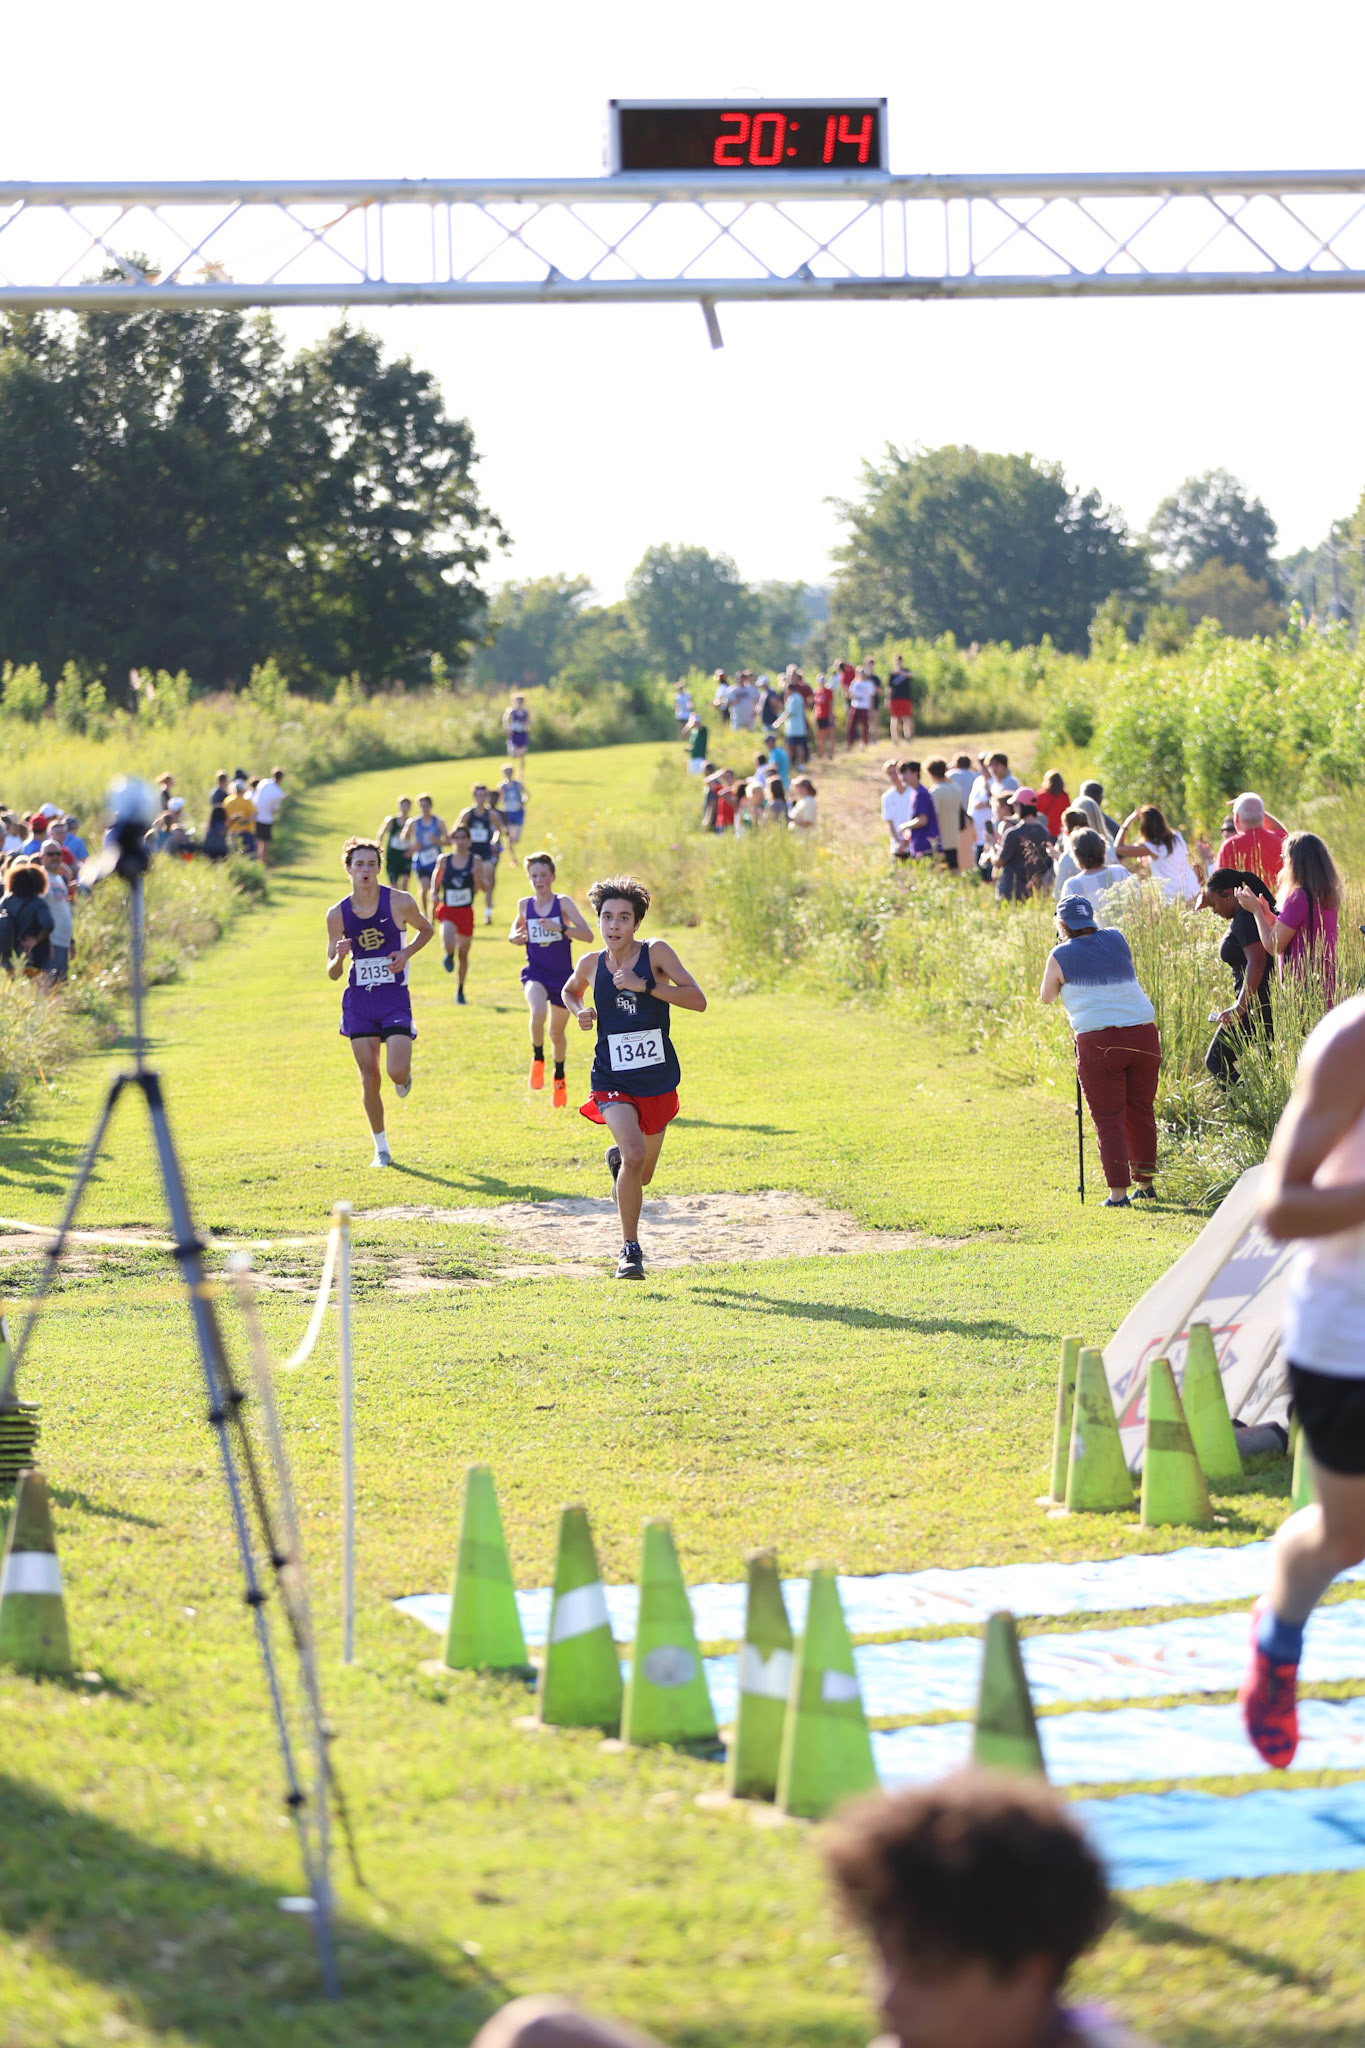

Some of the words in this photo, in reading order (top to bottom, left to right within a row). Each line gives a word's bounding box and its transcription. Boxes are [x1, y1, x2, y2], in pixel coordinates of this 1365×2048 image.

[712, 112, 874, 166] 20:14
[360, 965, 390, 980] 2135
[616, 996, 636, 1014] SBA
[615, 1040, 658, 1063] 1342
